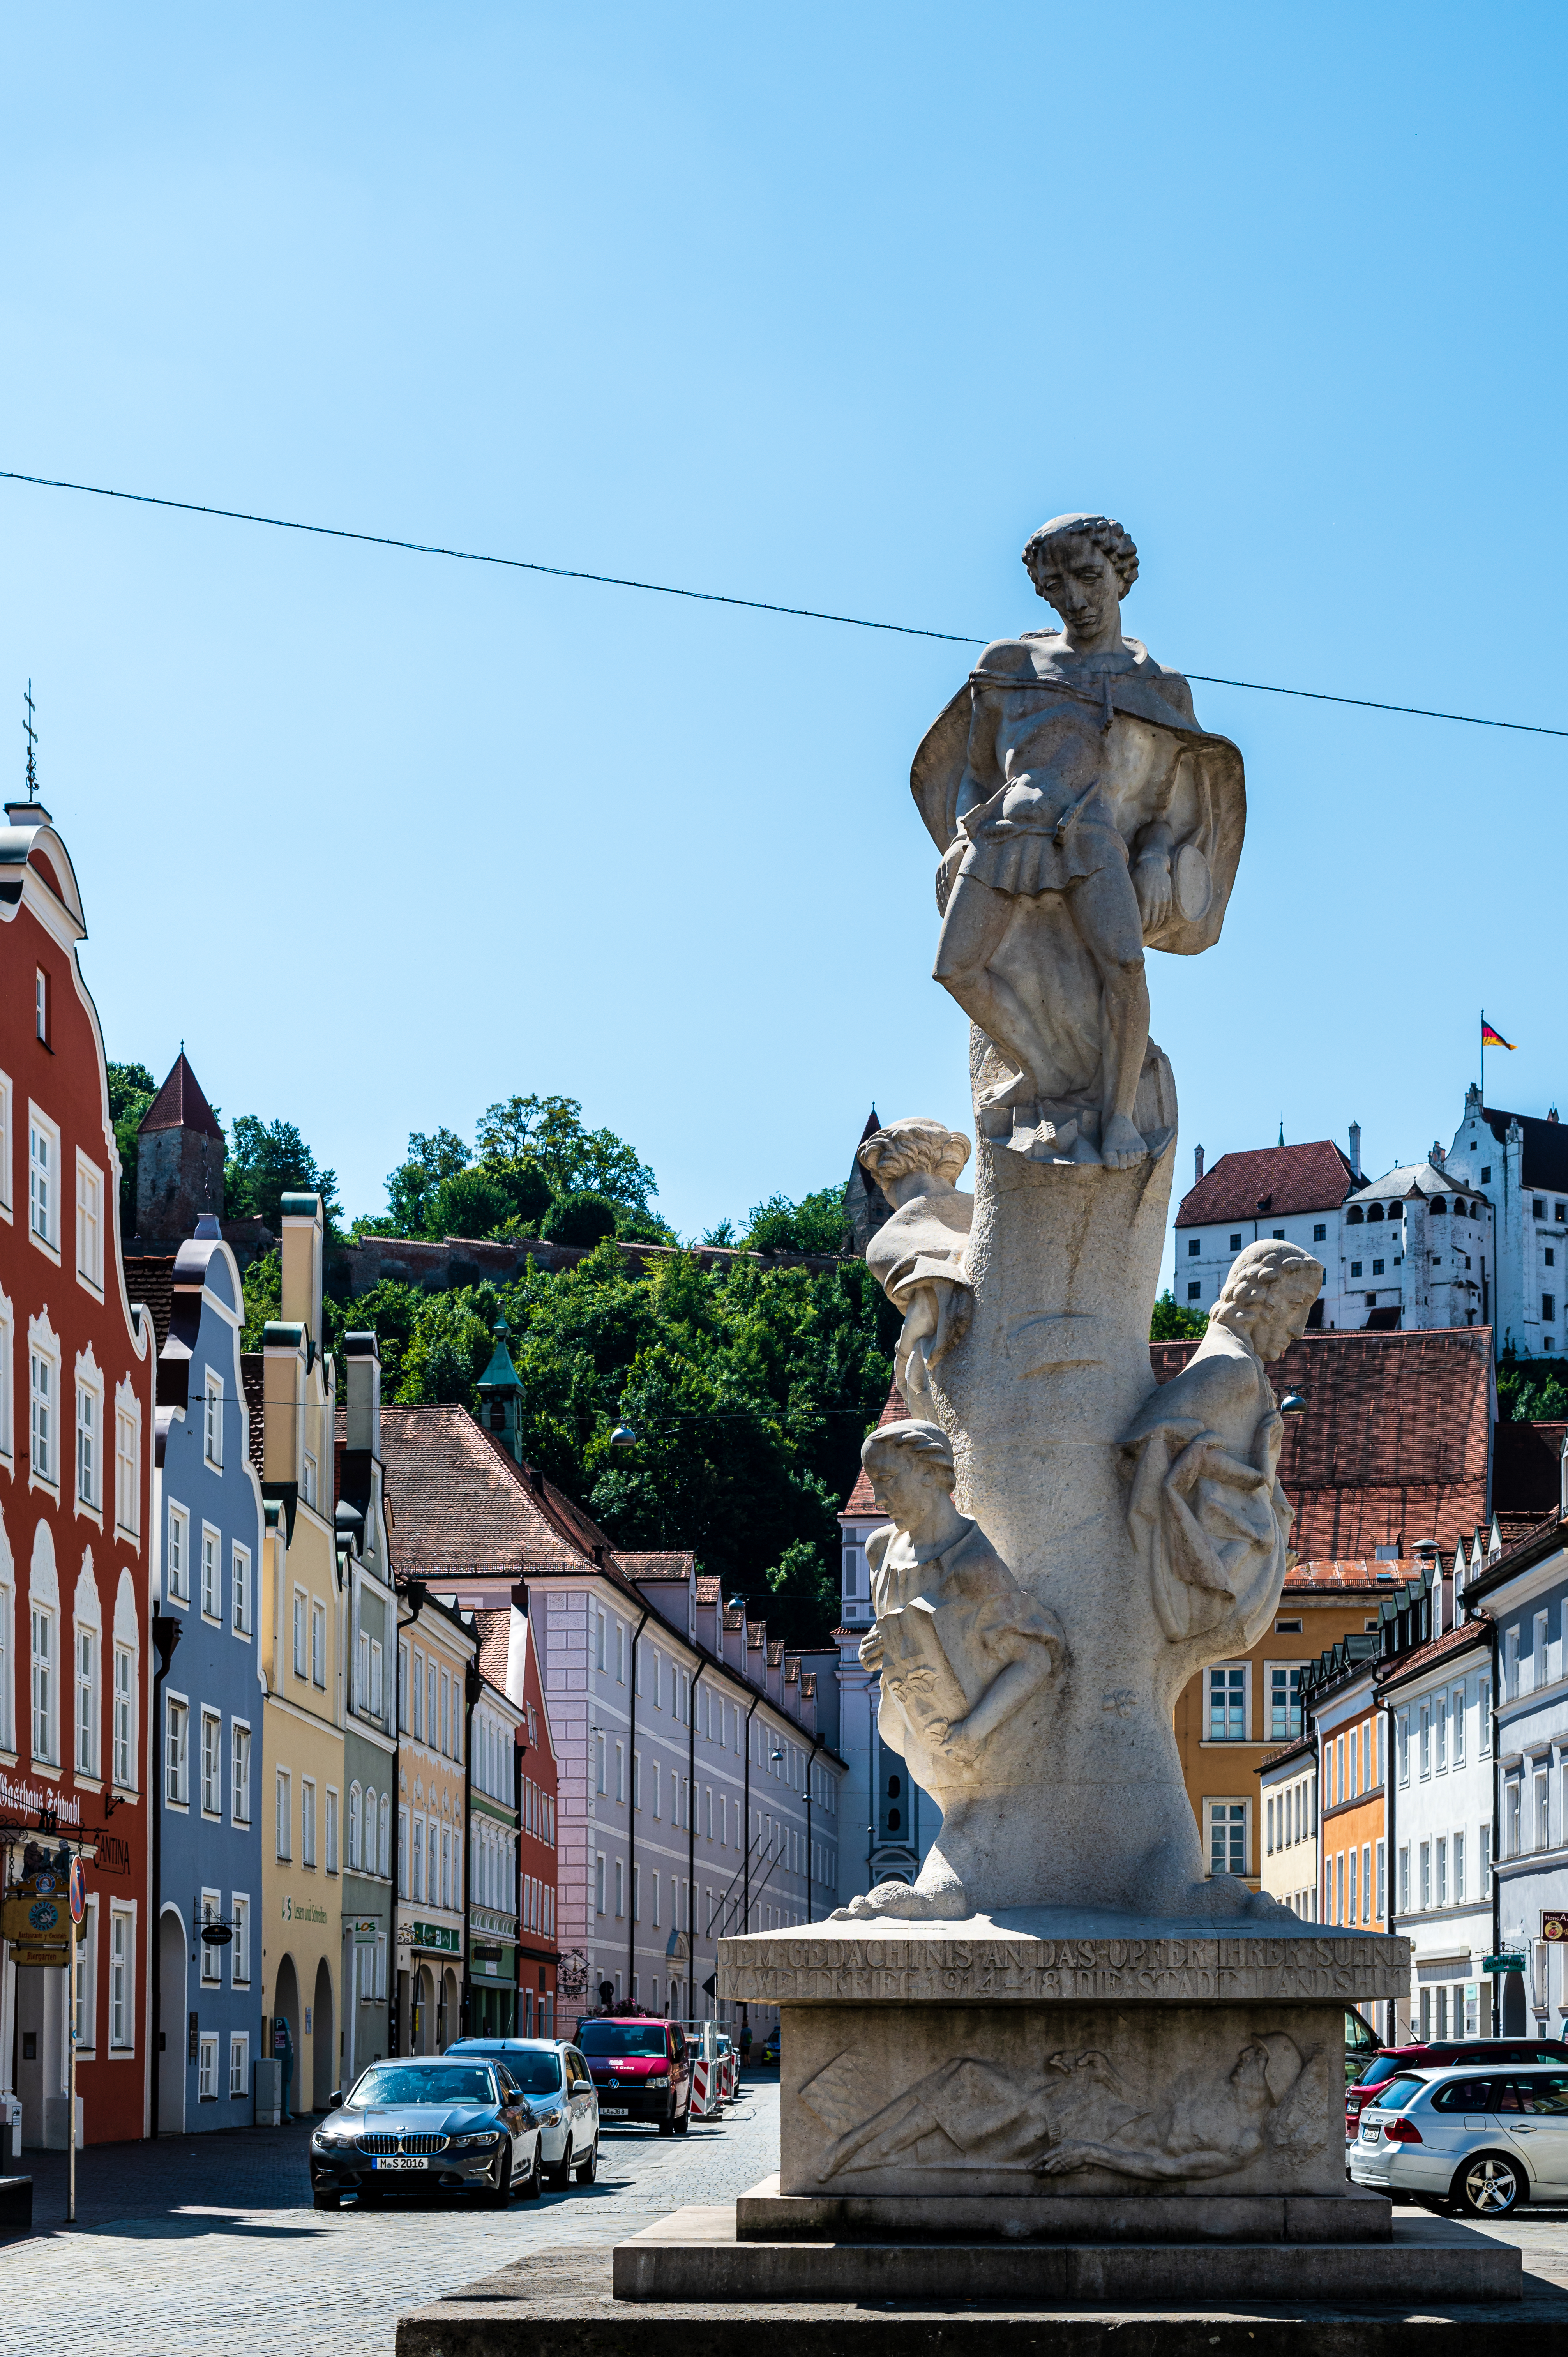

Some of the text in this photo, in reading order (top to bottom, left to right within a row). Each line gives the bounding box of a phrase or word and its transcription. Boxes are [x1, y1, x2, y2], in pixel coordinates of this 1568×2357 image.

[0, 1773, 80, 1828] Gasthaus Schwabl
[93, 1834, 131, 1875] CANTINA
[31, 1902, 55, 1914] CANTINA
[30, 1917, 57, 1929] ENSENADA
[355, 1922, 376, 1932] LOS
[27, 1952, 57, 1961] Biergarten
[720, 1940, 777, 1967] DEM
[984, 1940, 1023, 1968] AN
[1036, 1940, 1097, 1968] DAS
[1109, 1940, 1207, 1967] OPFER
[1485, 1959, 1524, 1970] REISEPARADIES
[754, 1970, 918, 1998] WELTKRIEG
[1076, 1970, 1121, 1998] DIE
[1138, 1970, 1238, 1998] STADT
[1255, 1968, 1410, 1997] LANDSHUT
[276, 2020, 283, 2029] P
[380, 2159, 424, 2168] M S 2016
